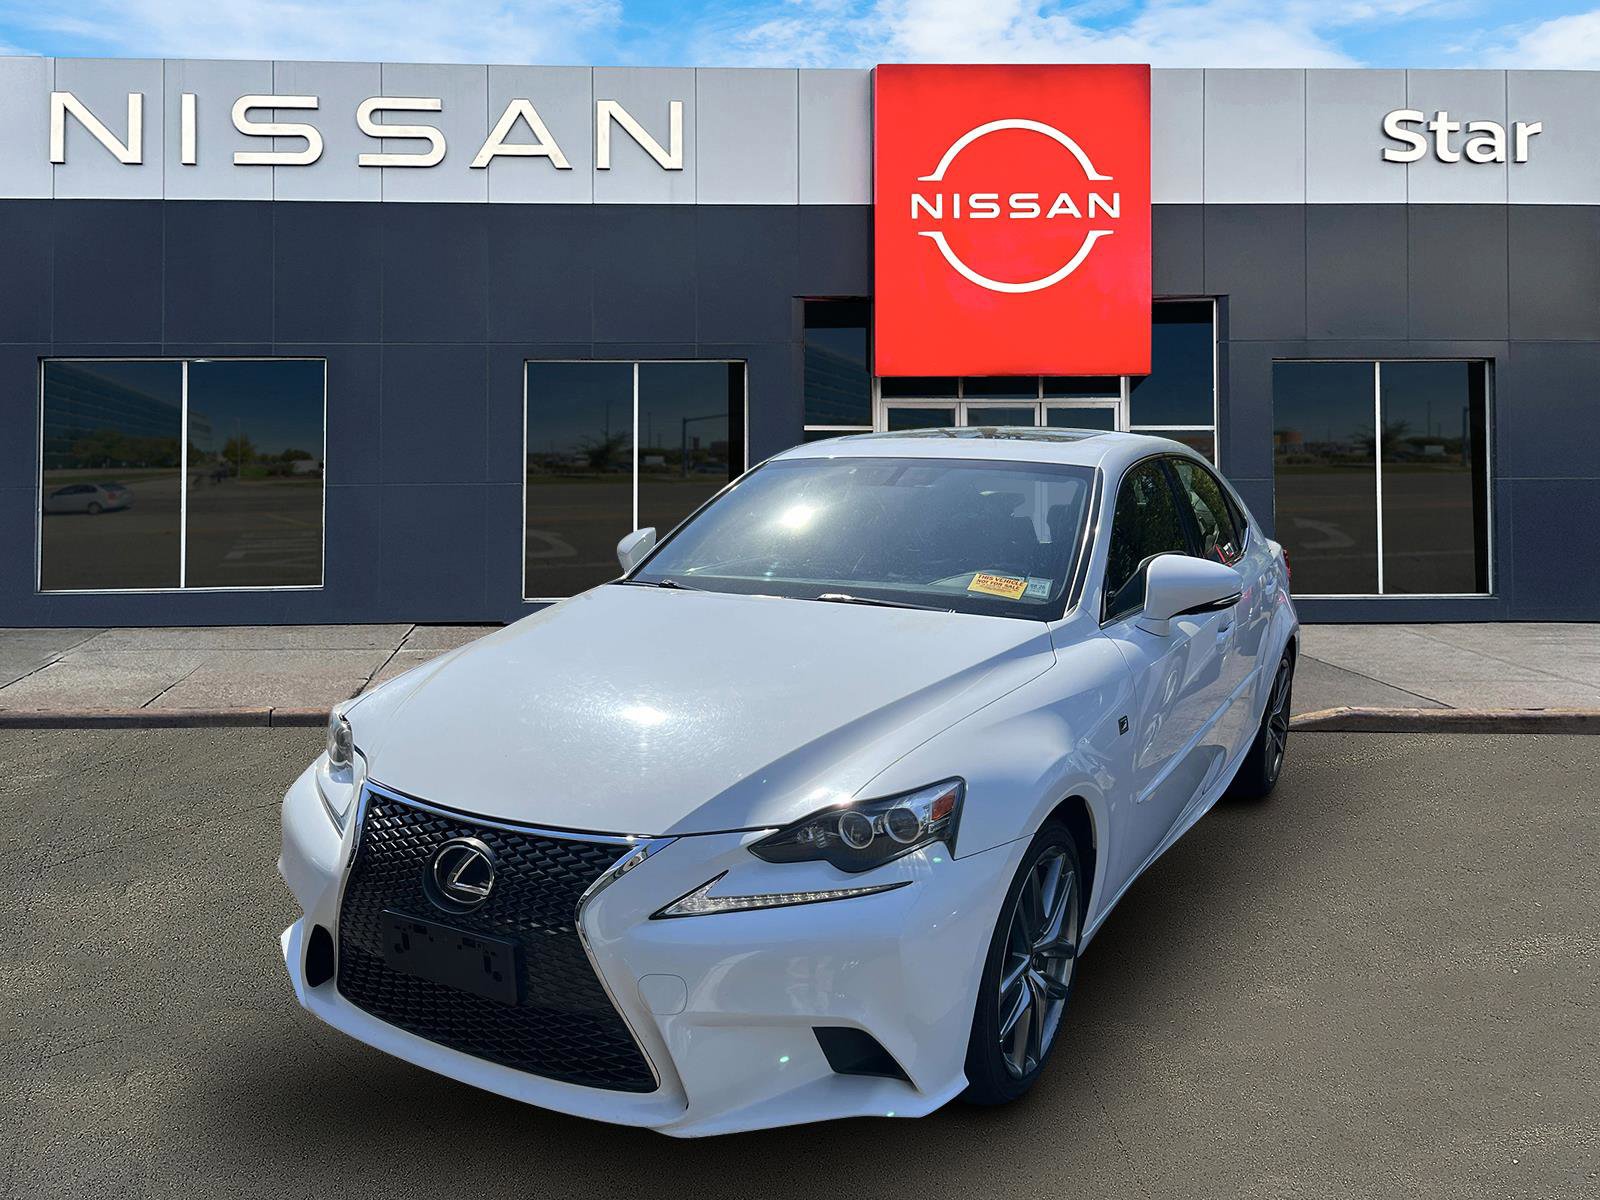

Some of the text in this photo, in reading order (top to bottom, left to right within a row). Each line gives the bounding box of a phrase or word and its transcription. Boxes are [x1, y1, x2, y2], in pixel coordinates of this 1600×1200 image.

[50, 92, 684, 170] NISSAN
[1381, 108, 1543, 164] Star
[910, 192, 1121, 220] NISSAN
[995, 577, 1023, 587] VEHICLE
